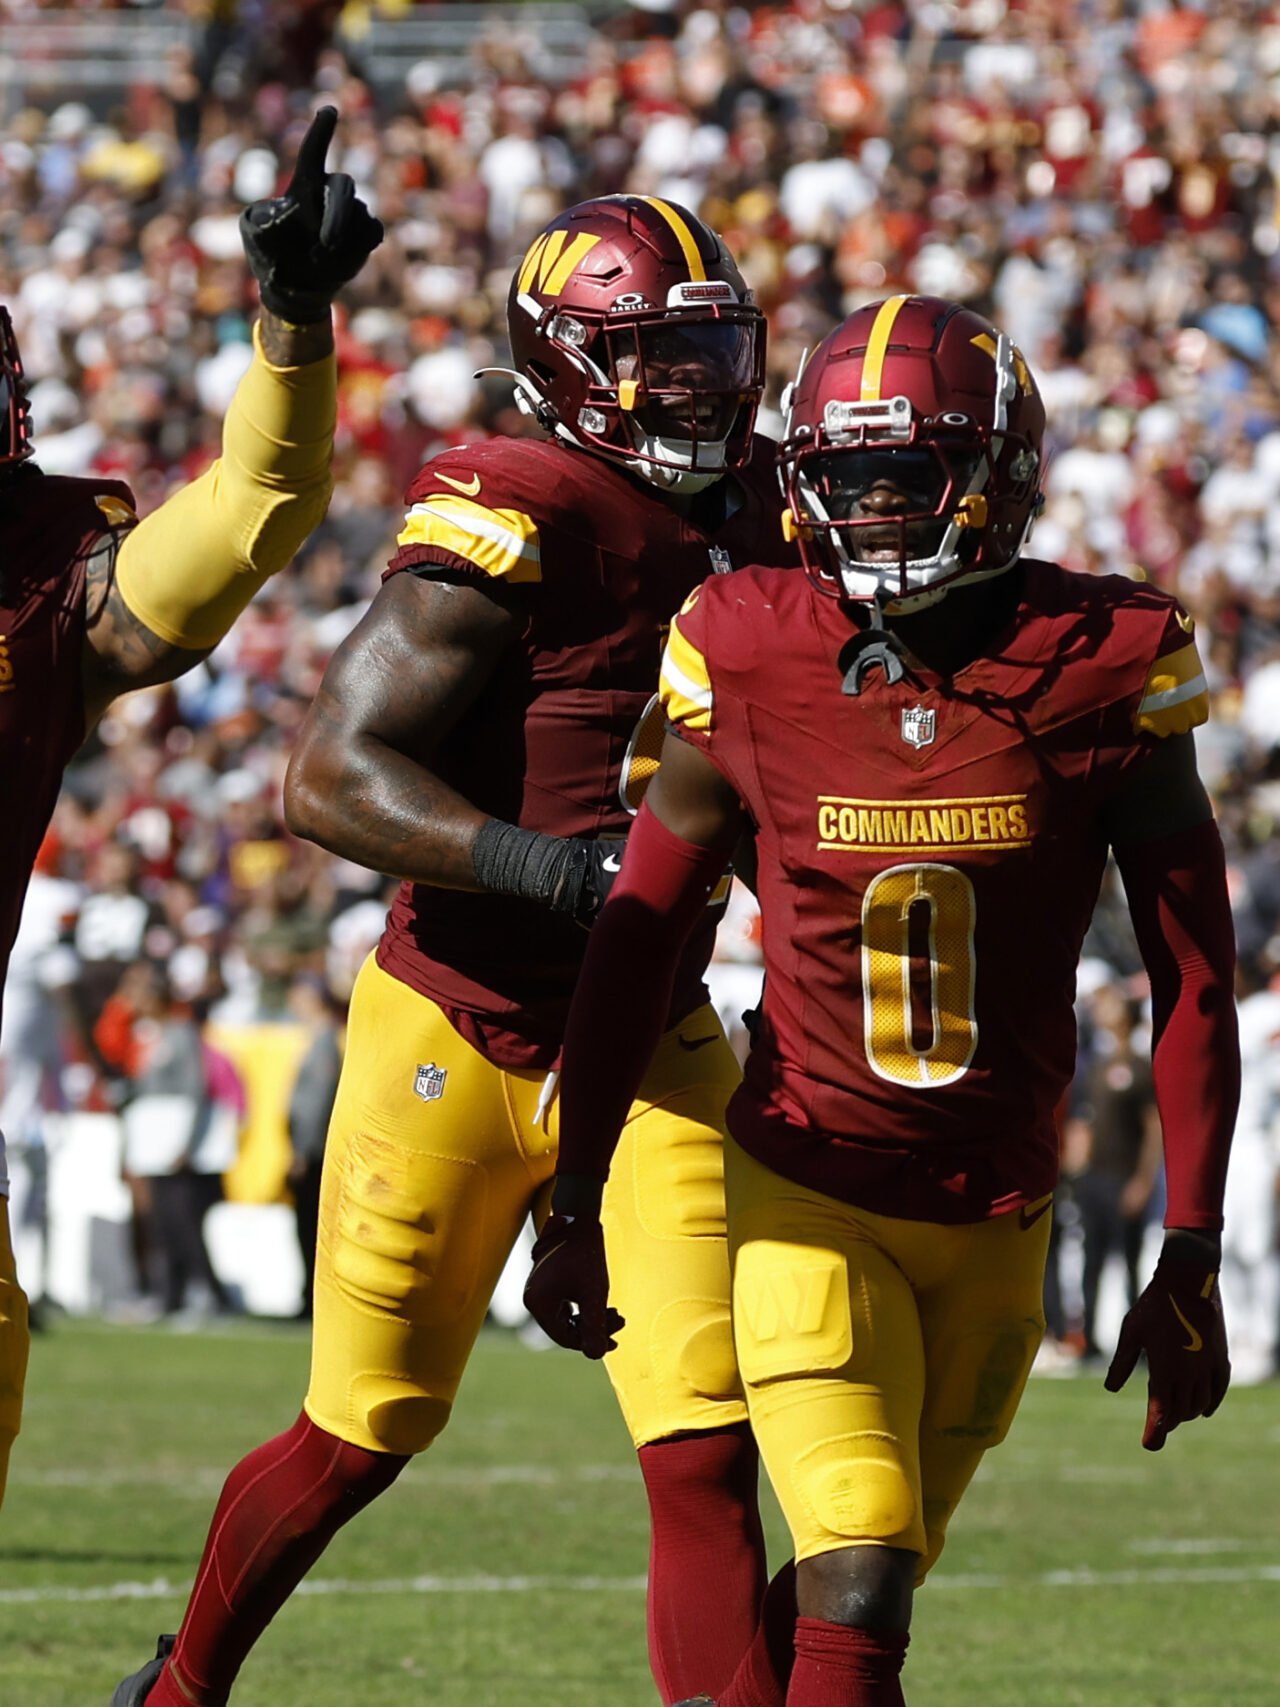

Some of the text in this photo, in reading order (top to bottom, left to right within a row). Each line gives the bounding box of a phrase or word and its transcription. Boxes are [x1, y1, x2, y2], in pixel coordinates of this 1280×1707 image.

[610, 303, 651, 313] OAKLEY
[818, 804, 1029, 843] COMMANDERS
[861, 862, 978, 1089] 0
